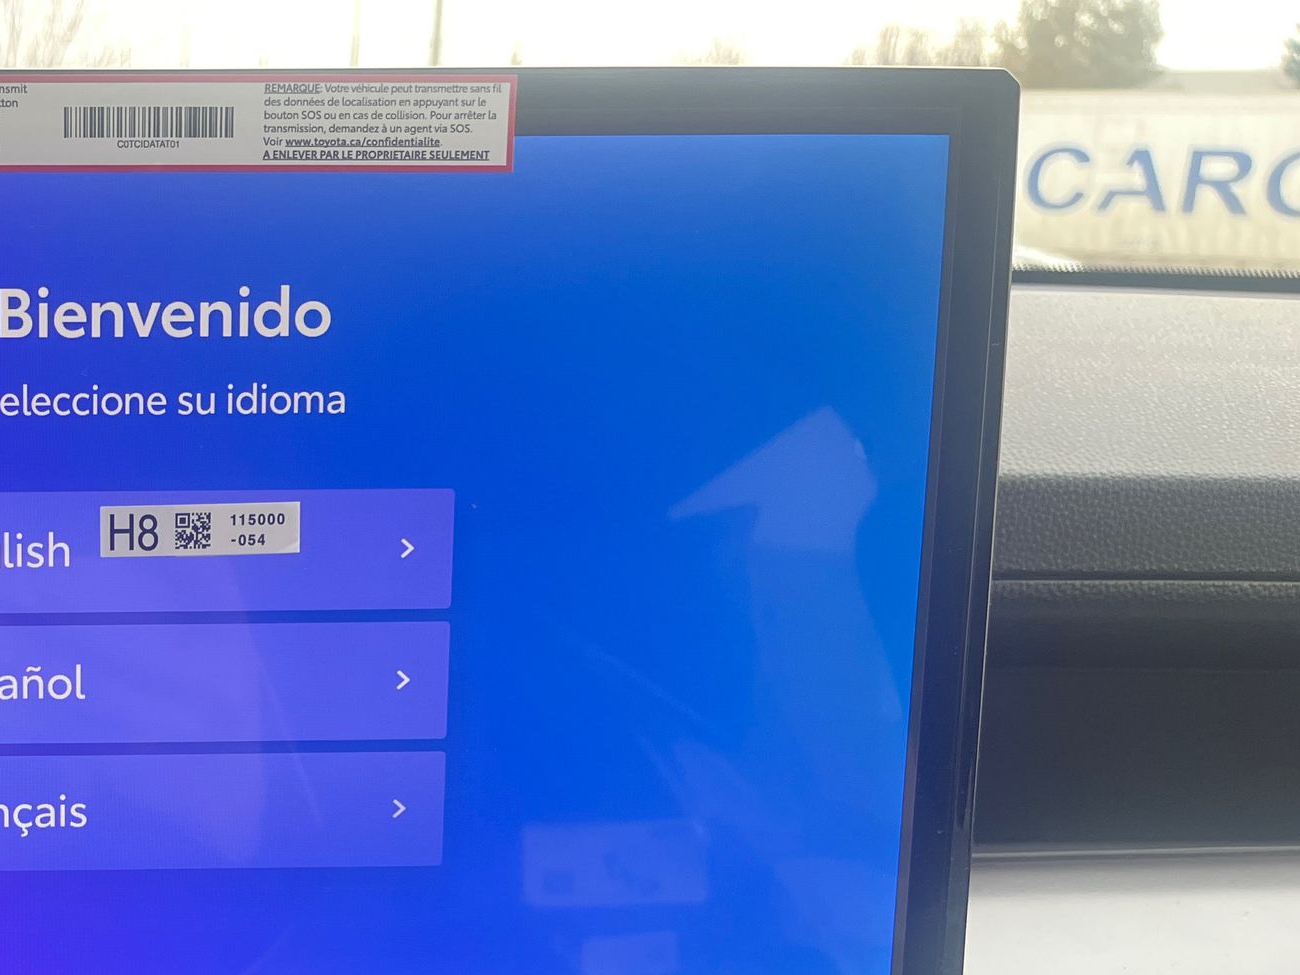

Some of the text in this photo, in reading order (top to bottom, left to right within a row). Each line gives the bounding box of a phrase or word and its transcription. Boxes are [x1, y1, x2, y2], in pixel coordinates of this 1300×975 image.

[264, 83, 502, 95] REMARQUE: Votre véhicule peut transmettre sans fil
[264, 97, 281, 106] des
[283, 97, 325, 106] données
[327, 97, 339, 106] de
[342, 97, 396, 106] localisation
[413, 98, 459, 108] appuyant
[478, 97, 486, 106] le
[264, 110, 299, 119] bouton
[301, 110, 321, 119] SOS
[371, 110, 383, 119] de
[385, 110, 427, 119] collision.
[430, 111, 453, 119] Pour
[454, 110, 485, 119] arrêter
[488, 110, 496, 119] la
[263, 124, 473, 135] transmission, demandez à un agent via SOS.
[263, 136, 442, 147] Voir www.toyota.ca/confidentialite.
[263, 150, 490, 161] A ENLEVER PAR LE PROPRIETAIRE SEULEMENT
[177, 390, 216, 416] su
[226, 383, 347, 416] idioma
[109, 513, 285, 551] H8 115000
[231, 534, 266, 546] -054
